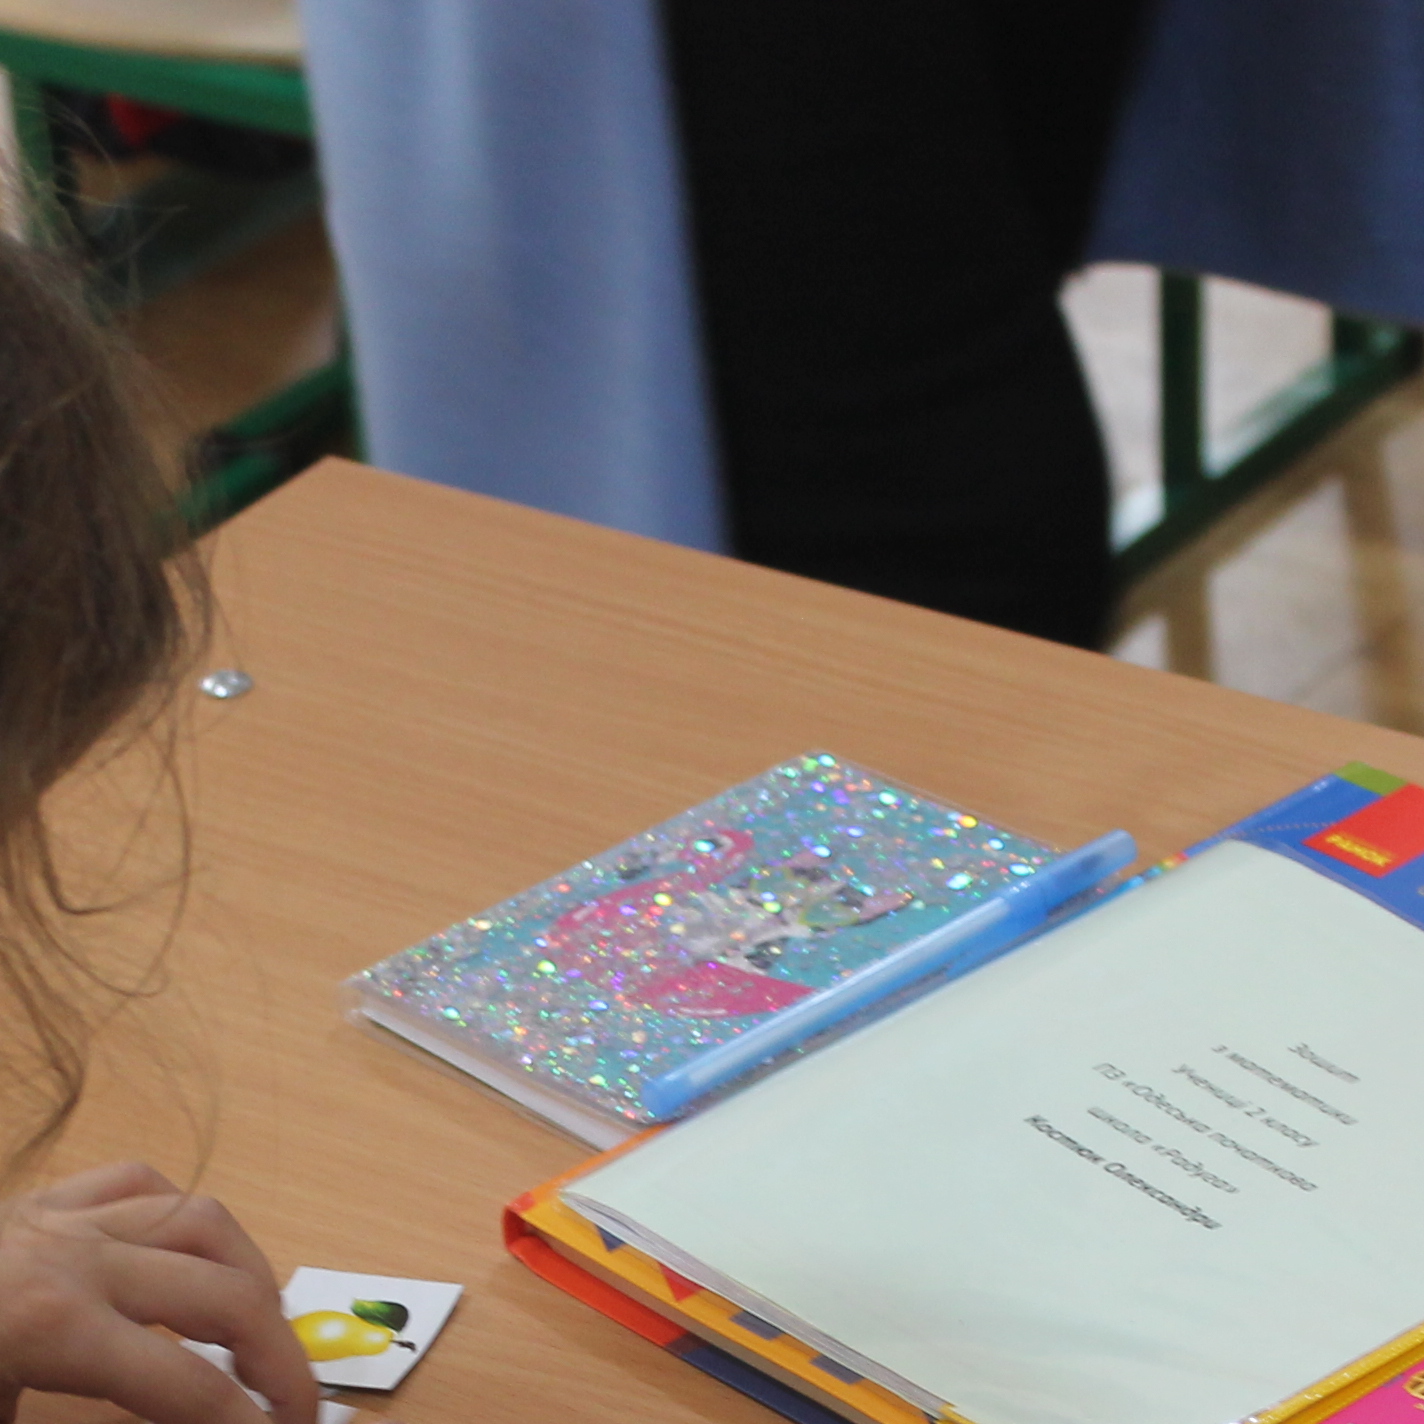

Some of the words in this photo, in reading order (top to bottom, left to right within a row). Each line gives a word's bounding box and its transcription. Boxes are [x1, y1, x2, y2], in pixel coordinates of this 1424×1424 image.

[1225, 1051, 1359, 1126] математики
[1287, 1042, 1361, 1084] Зошит
[1086, 1106, 1152, 1145] школа
[1243, 1106, 1266, 1119] 2
[1261, 1116, 1320, 1149] класу
[1023, 1114, 1106, 1164] Костюк
[1103, 1161, 1223, 1231] Олександри
[1208, 1132, 1319, 1192] початкова
